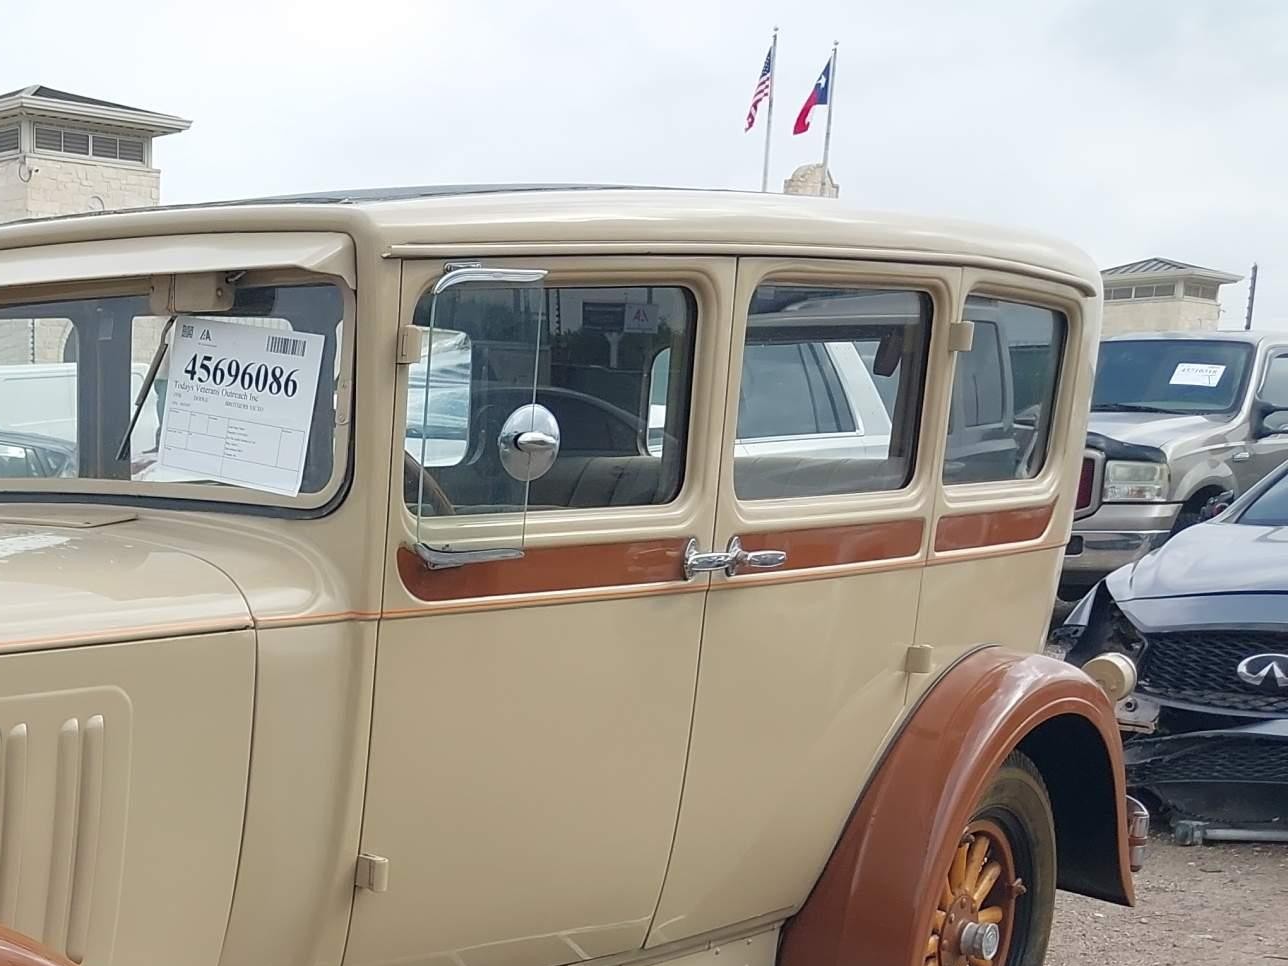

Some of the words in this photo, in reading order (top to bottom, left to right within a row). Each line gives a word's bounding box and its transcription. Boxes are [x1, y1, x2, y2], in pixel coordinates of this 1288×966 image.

[174, 380, 194, 393] Todays
[196, 385, 220, 396] Veterans
[221, 388, 248, 401] Outreach
[184, 353, 300, 398] 45696086
